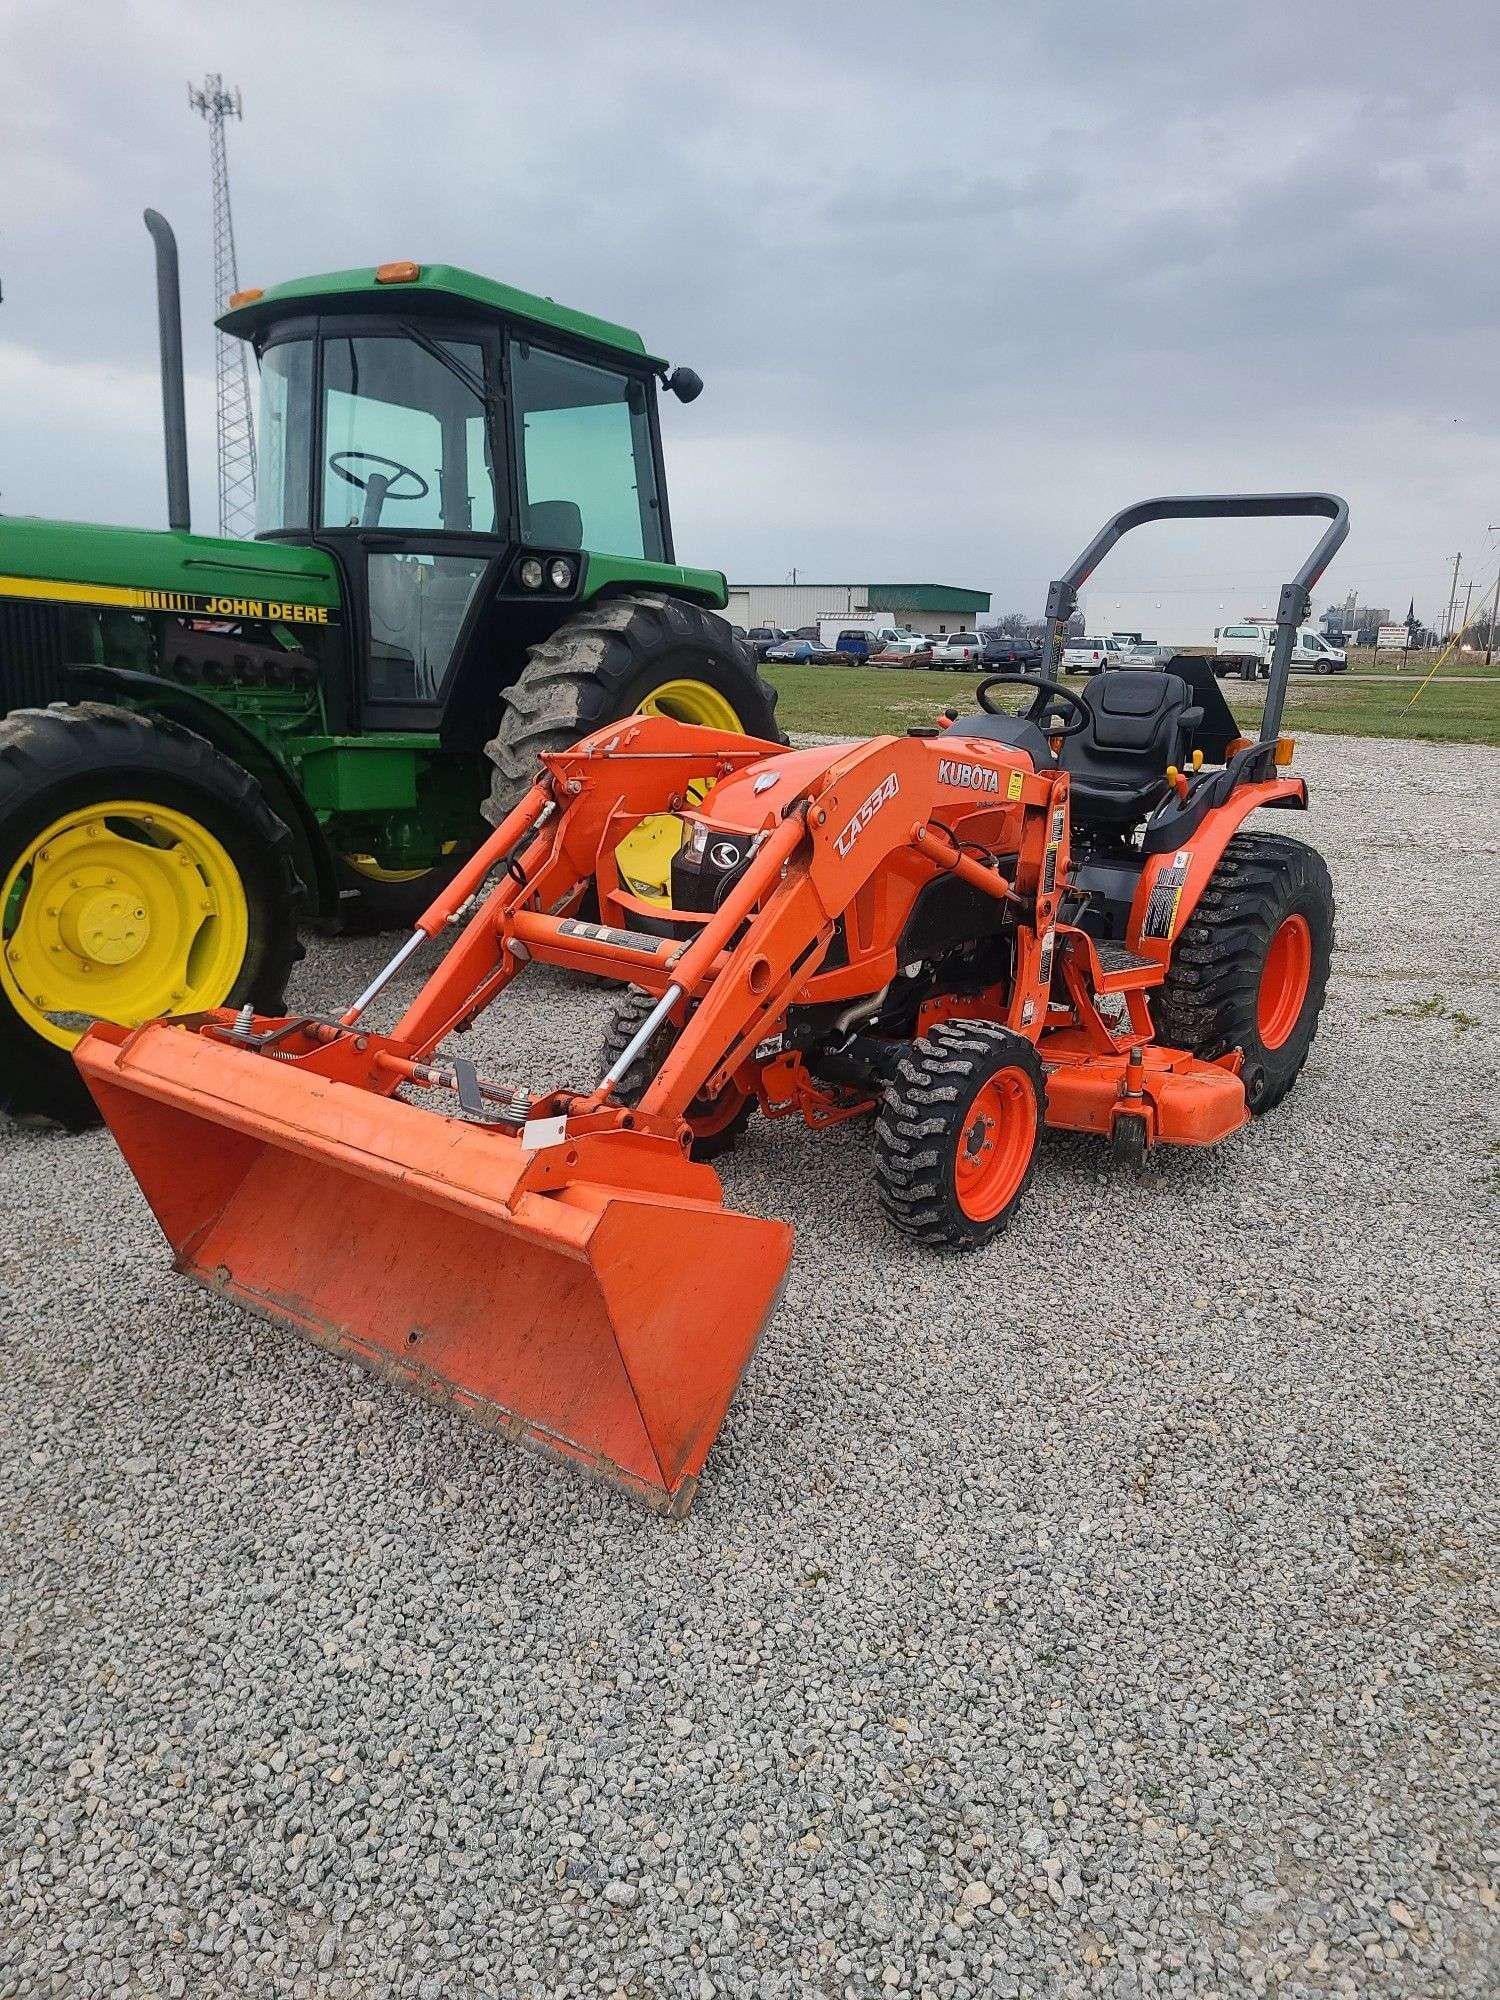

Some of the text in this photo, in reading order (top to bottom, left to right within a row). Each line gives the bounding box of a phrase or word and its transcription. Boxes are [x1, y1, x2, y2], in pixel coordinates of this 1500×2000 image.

[206, 598, 328, 622] JOHN DEERE
[937, 758, 999, 794] KUBOTA
[833, 772, 900, 859] LA534
